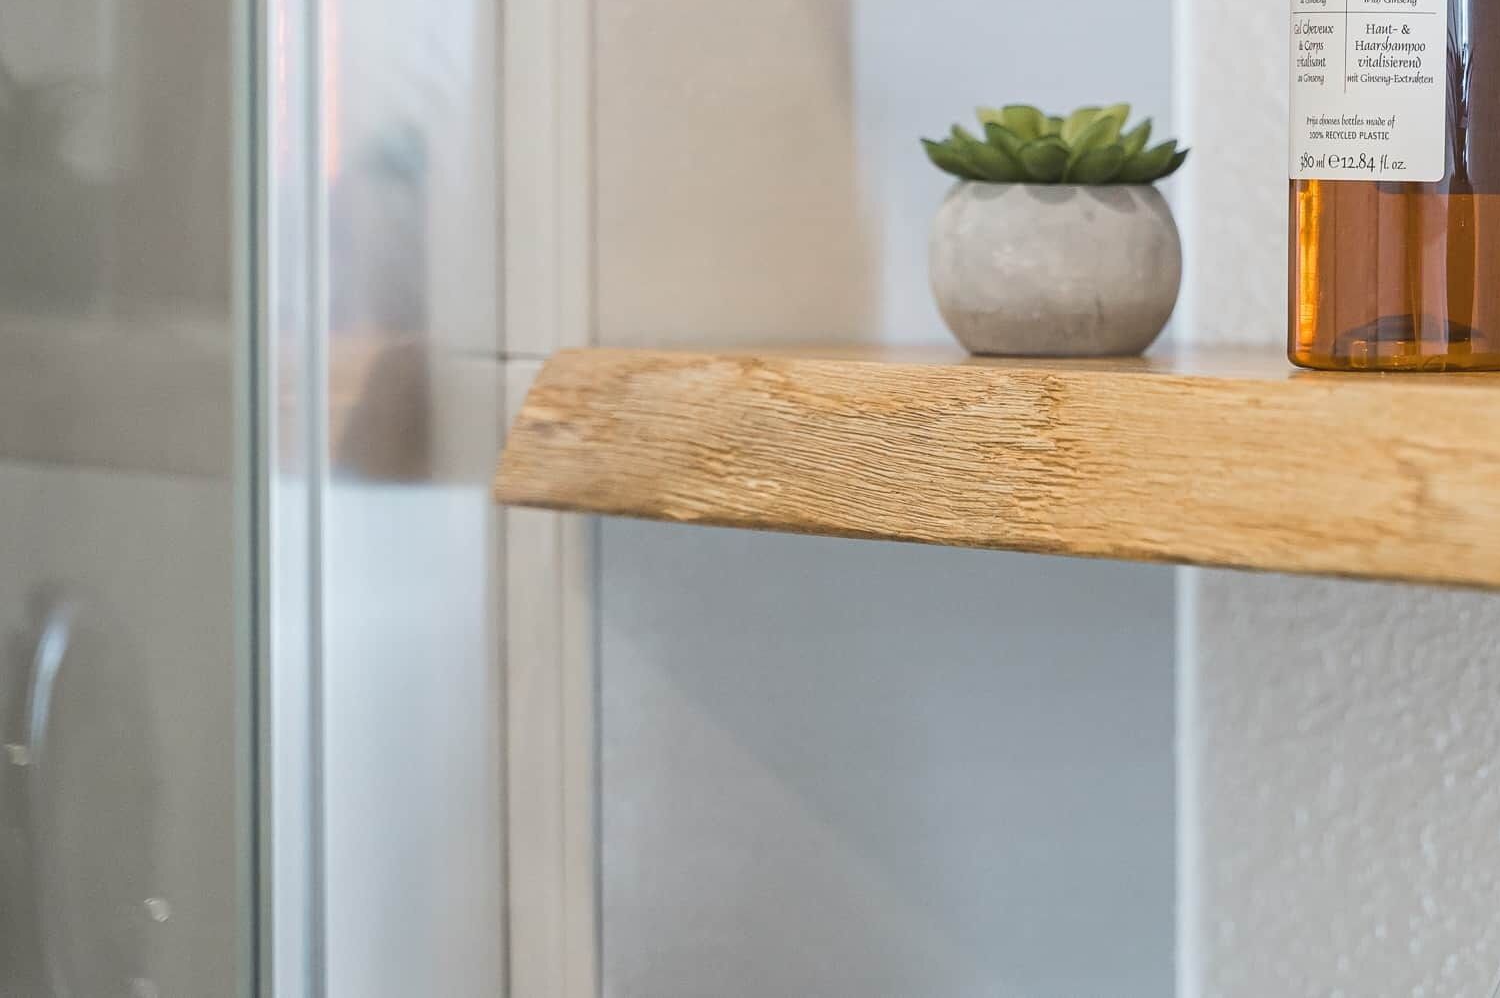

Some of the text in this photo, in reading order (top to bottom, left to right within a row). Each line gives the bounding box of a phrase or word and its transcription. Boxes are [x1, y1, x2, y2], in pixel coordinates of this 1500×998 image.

[1366, 23, 1410, 34] Haut- &
[1355, 36, 1426, 55] Haarshampoo
[1358, 53, 1422, 68] vitalisierend
[1347, 73, 1359, 83] mit
[1341, 113, 1364, 126] bottles
[1366, 116, 1386, 126] made
[1387, 114, 1396, 129] of
[1325, 131, 1357, 139] RECYCLED
[1359, 131, 1390, 140] PLASTIC
[1316, 153, 1326, 169] ml
[1391, 160, 1407, 170] oz.
